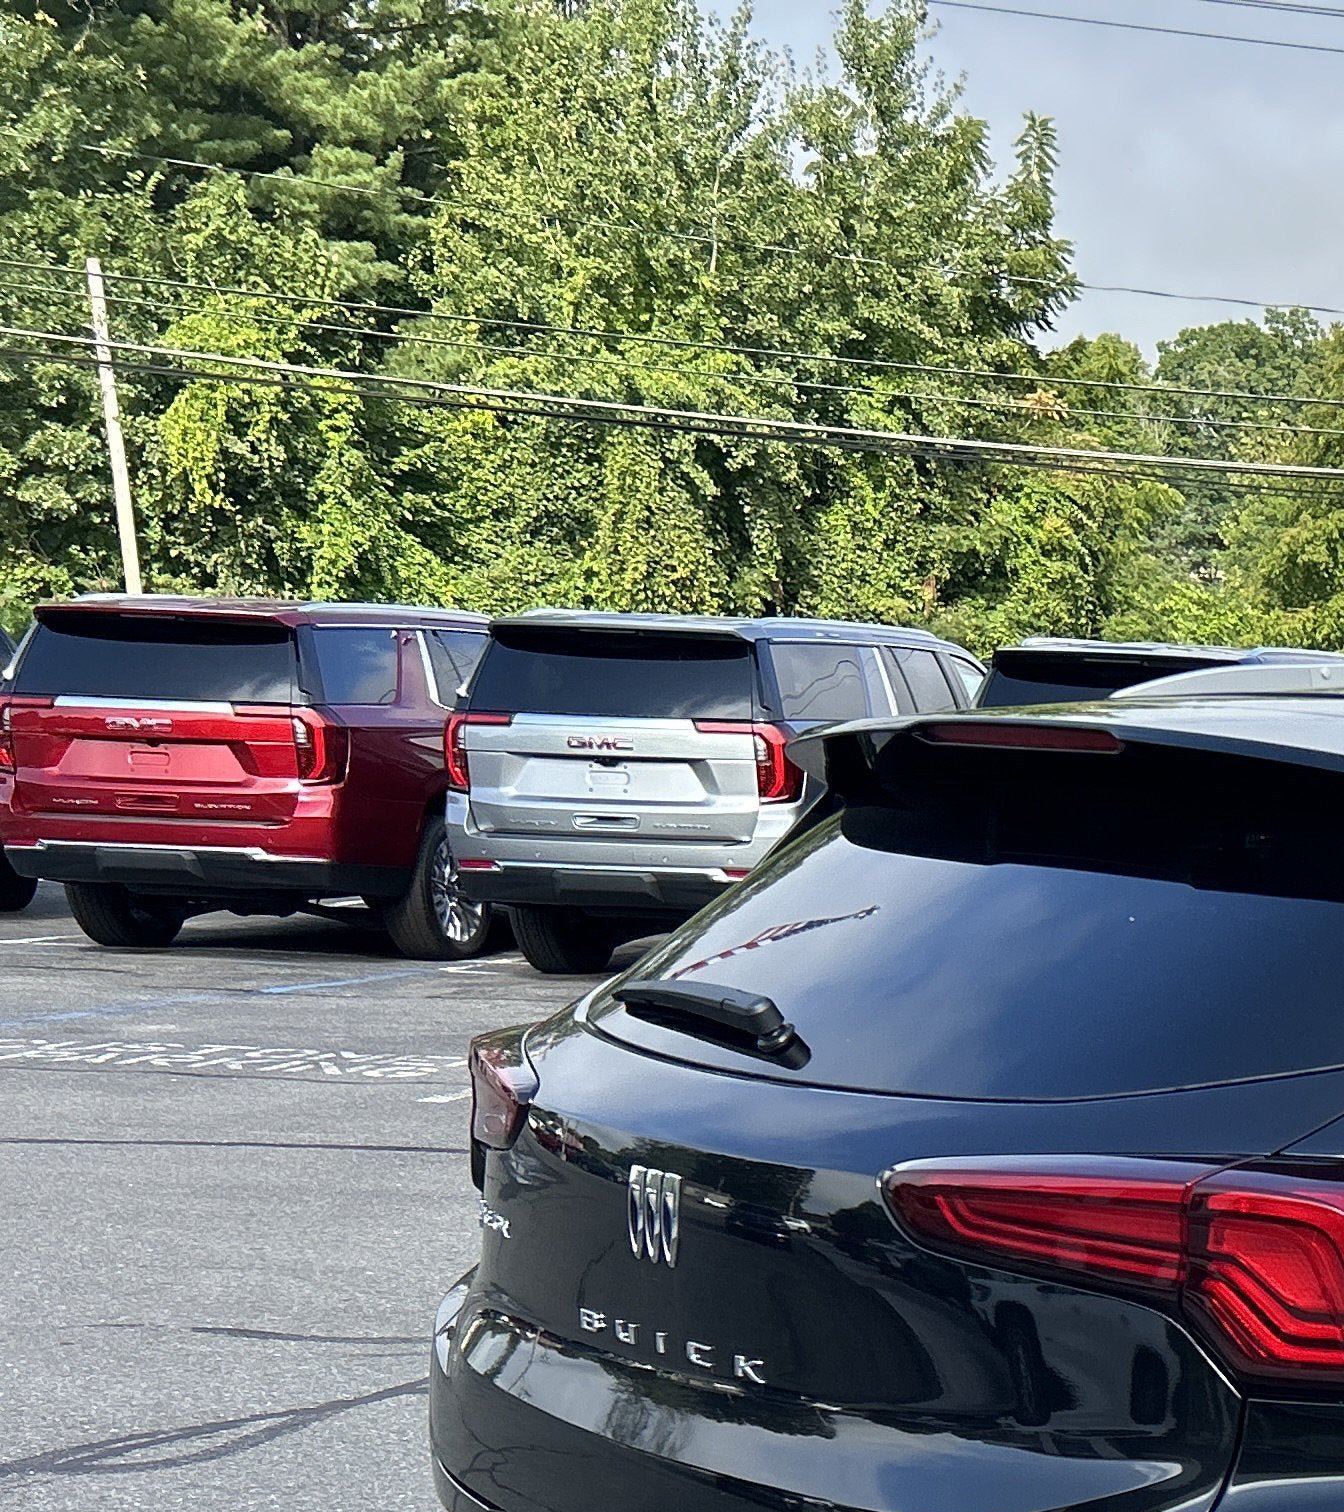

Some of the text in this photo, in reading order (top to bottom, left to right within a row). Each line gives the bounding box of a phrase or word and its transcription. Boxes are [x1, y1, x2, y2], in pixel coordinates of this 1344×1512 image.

[567, 736, 634, 750] GMC
[0, 1039, 469, 1068] CUSTOME
[579, 1307, 768, 1384] BUICK
